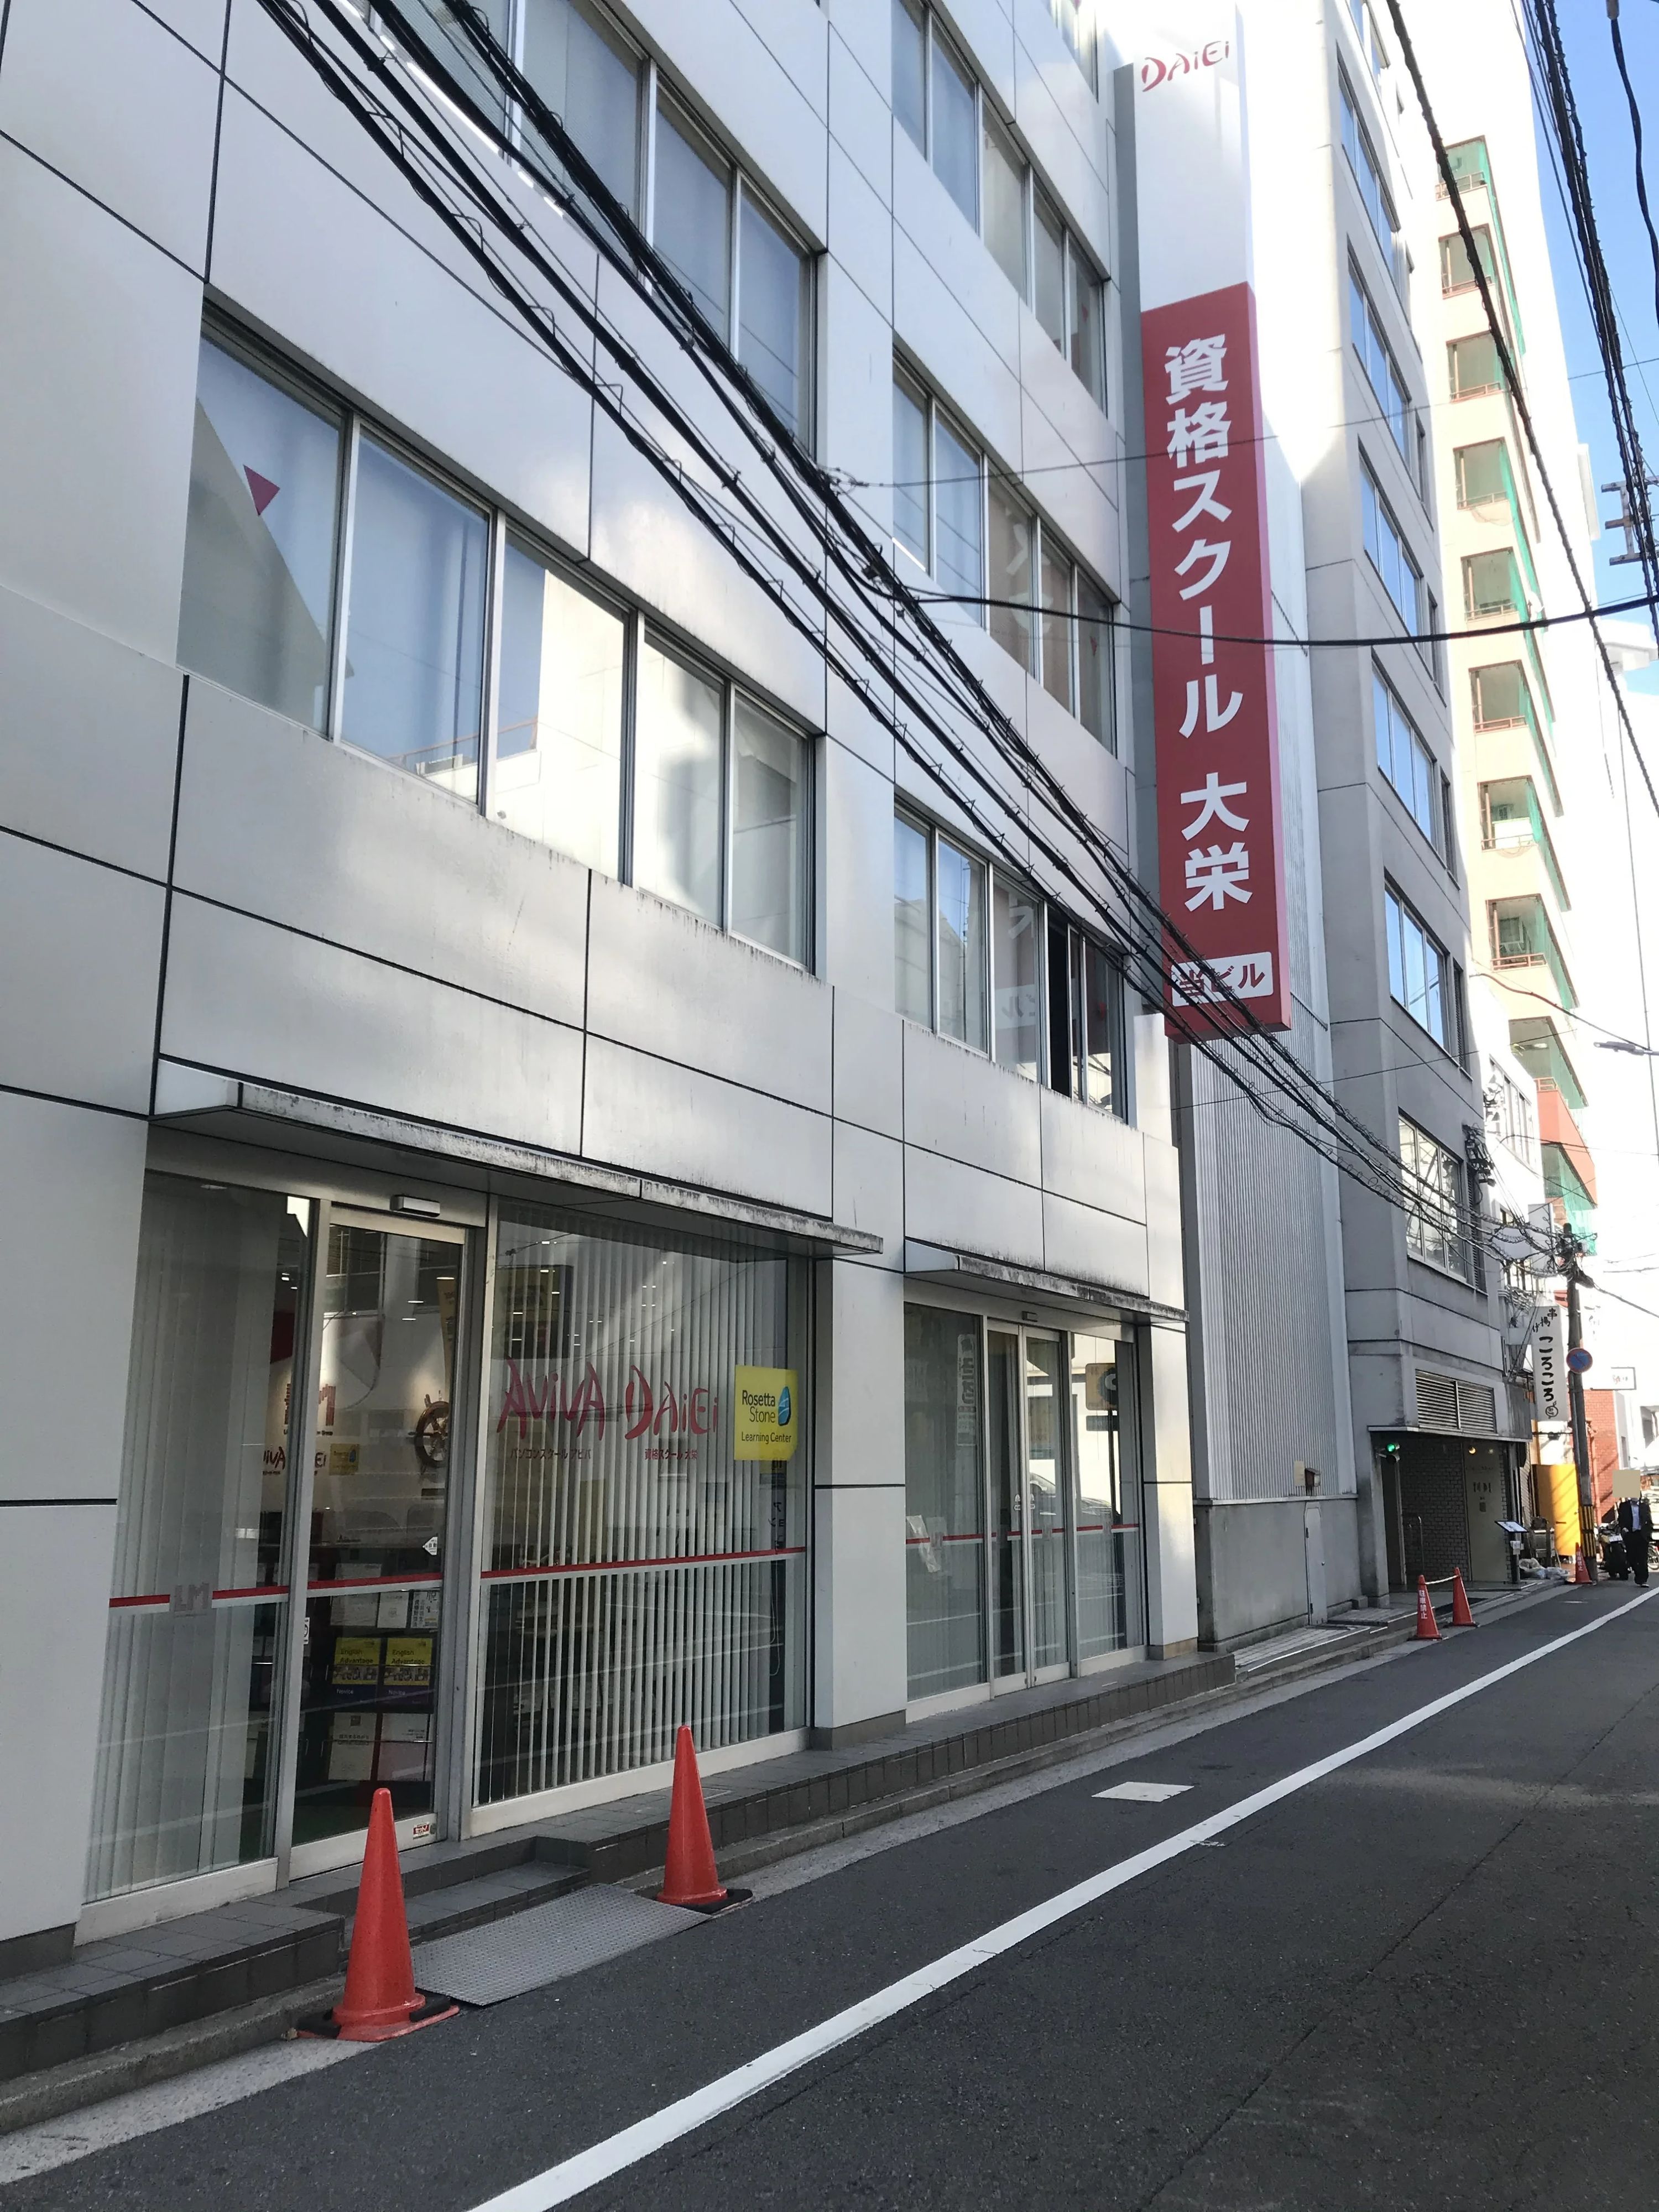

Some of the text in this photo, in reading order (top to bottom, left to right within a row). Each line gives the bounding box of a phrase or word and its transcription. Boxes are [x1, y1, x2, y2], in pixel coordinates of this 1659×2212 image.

[1164, 333, 1253, 911] 資格スクール 大栄
[1538, 1336, 1554, 1402] ころころ
[742, 1390, 776, 1407] Rosetta
[749, 1407, 776, 1424] Stone
[741, 1432, 791, 1444] Learning Center
